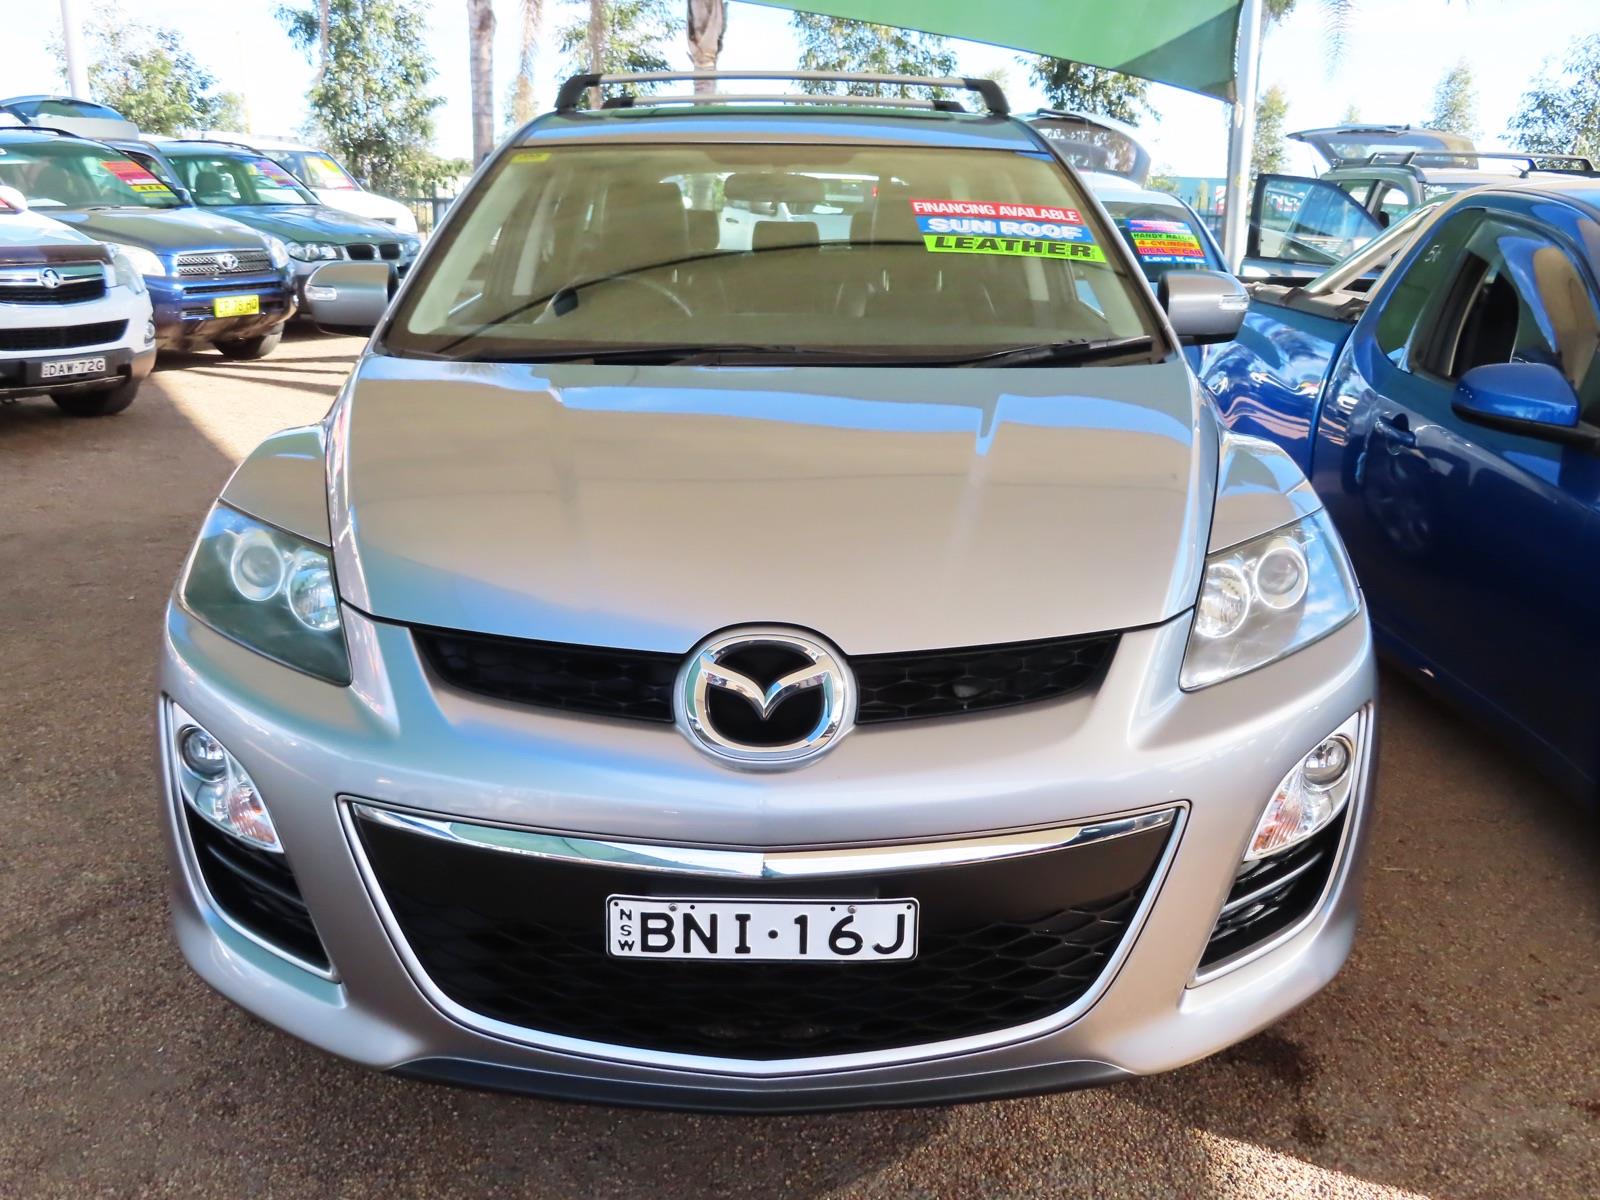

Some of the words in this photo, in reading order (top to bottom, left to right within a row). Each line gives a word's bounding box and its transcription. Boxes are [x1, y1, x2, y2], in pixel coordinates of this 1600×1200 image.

[913, 202, 996, 216] FINANCING
[999, 204, 1080, 222] AVAILABLE
[927, 217, 997, 235] SUN
[1000, 219, 1082, 240] ROOF
[934, 236, 1092, 257] LEATHER
[1138, 247, 1166, 255] IDEAL
[618, 908, 635, 951] NSW
